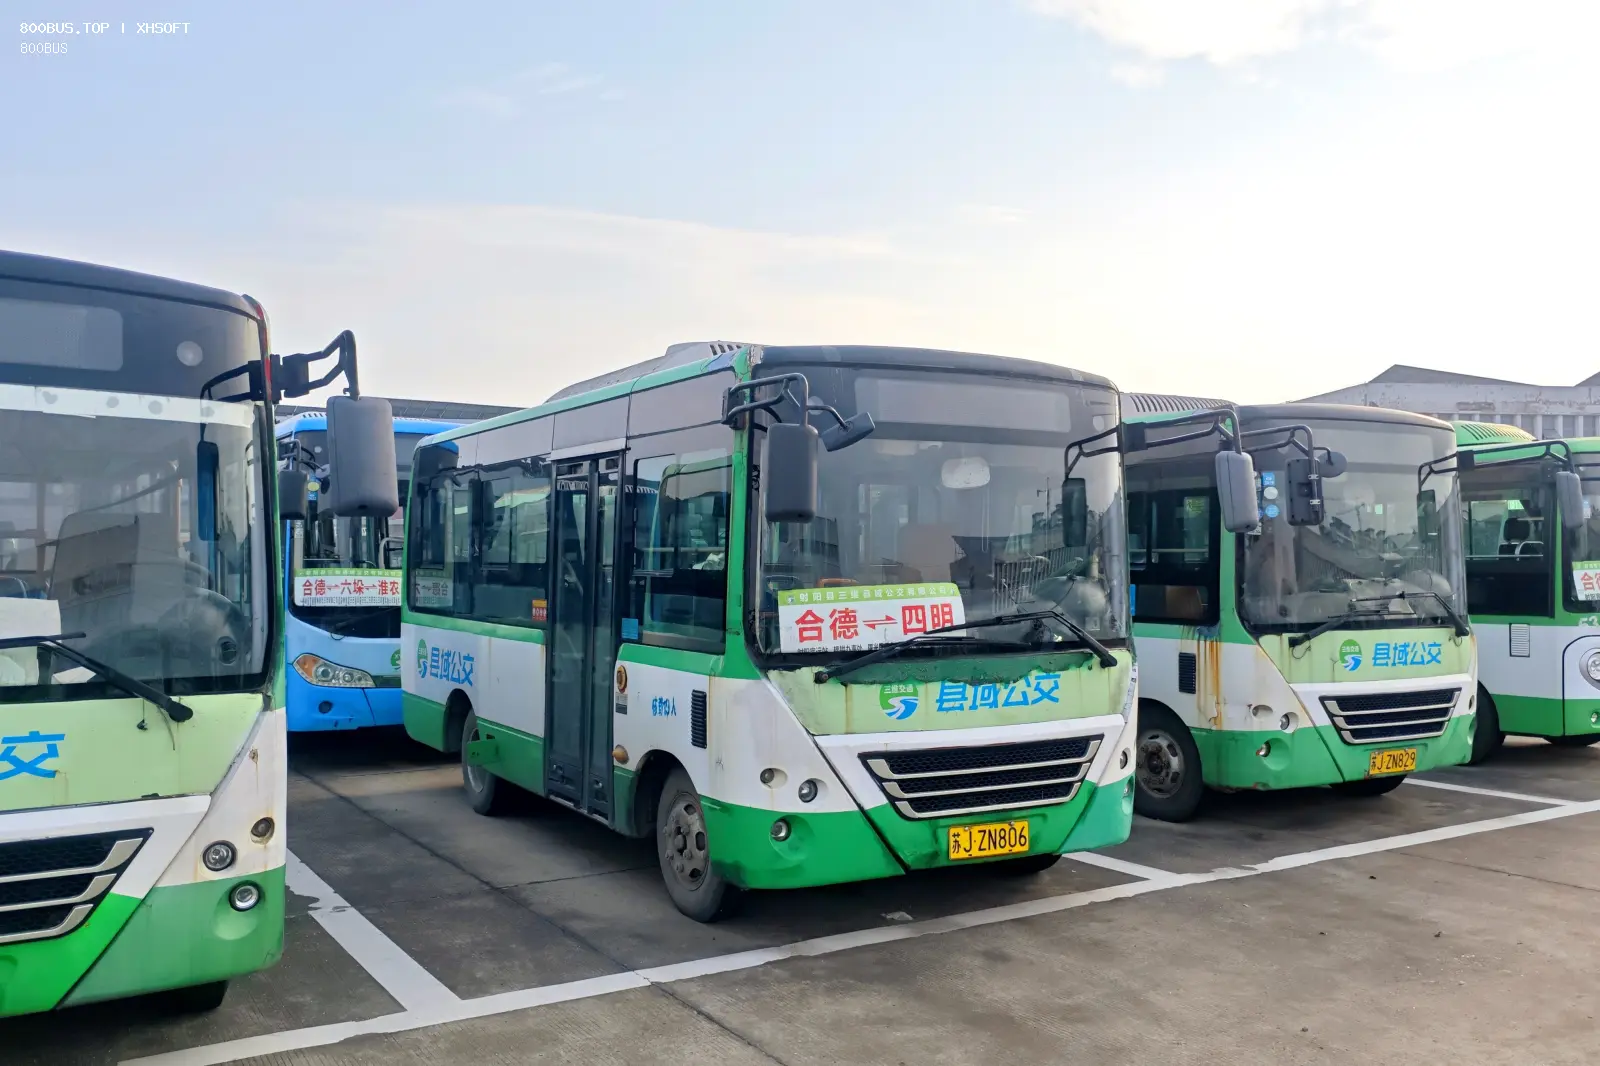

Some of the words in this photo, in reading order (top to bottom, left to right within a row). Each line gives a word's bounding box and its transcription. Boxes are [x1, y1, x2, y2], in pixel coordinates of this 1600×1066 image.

[302, 579, 327, 597] 合德
[794, 607, 860, 643] 合德
[901, 602, 955, 636] 四明
[429, 646, 475, 687] 县域公交
[1372, 641, 1442, 667] 县域公交
[0, 730, 66, 781] 交
